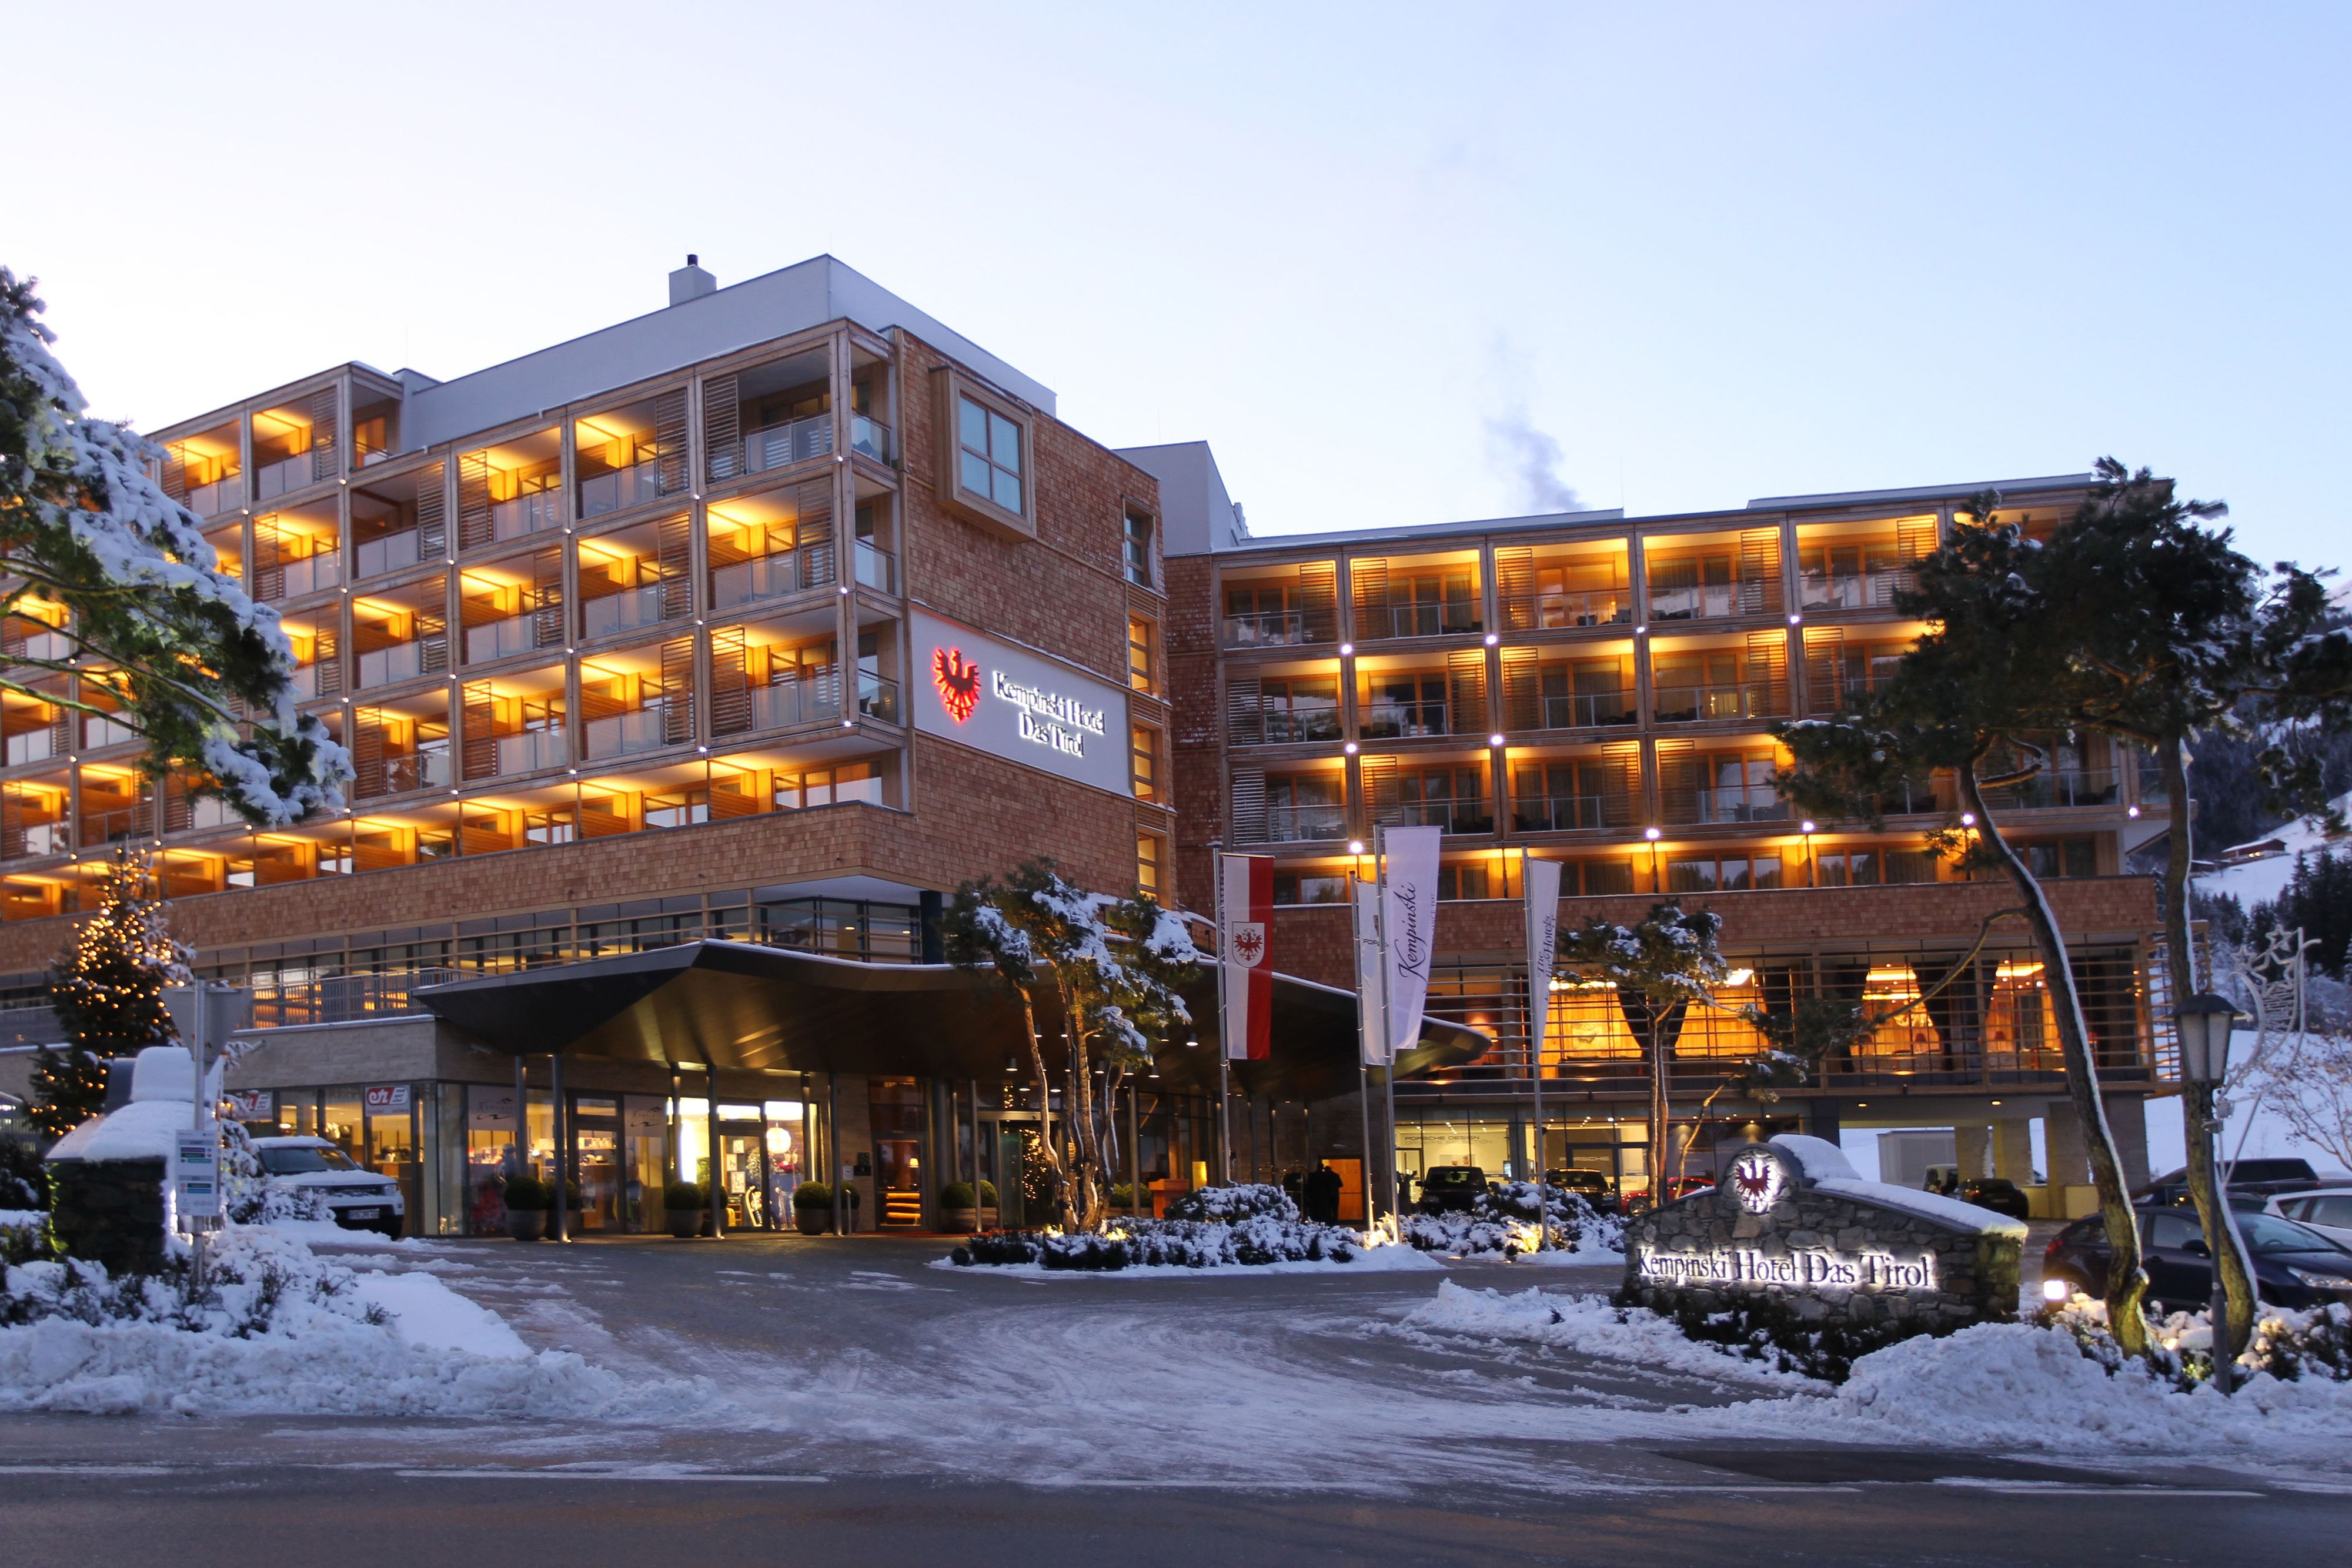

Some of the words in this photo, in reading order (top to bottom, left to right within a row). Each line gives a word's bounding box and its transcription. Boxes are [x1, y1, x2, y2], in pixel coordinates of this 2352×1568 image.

[994, 671, 1067, 720] Kempinski
[1068, 700, 1105, 734] Hotel
[1020, 713, 1049, 743] Das
[1049, 724, 1084, 757] Tirol
[1394, 882, 1428, 984] Kempinski
[1543, 915, 1553, 954] Hotels
[1637, 1248, 1726, 1284] Kempinski
[1736, 1251, 1796, 1282] Hotel
[1805, 1253, 1855, 1283] Das
[1859, 1254, 1930, 1286] Tirol
